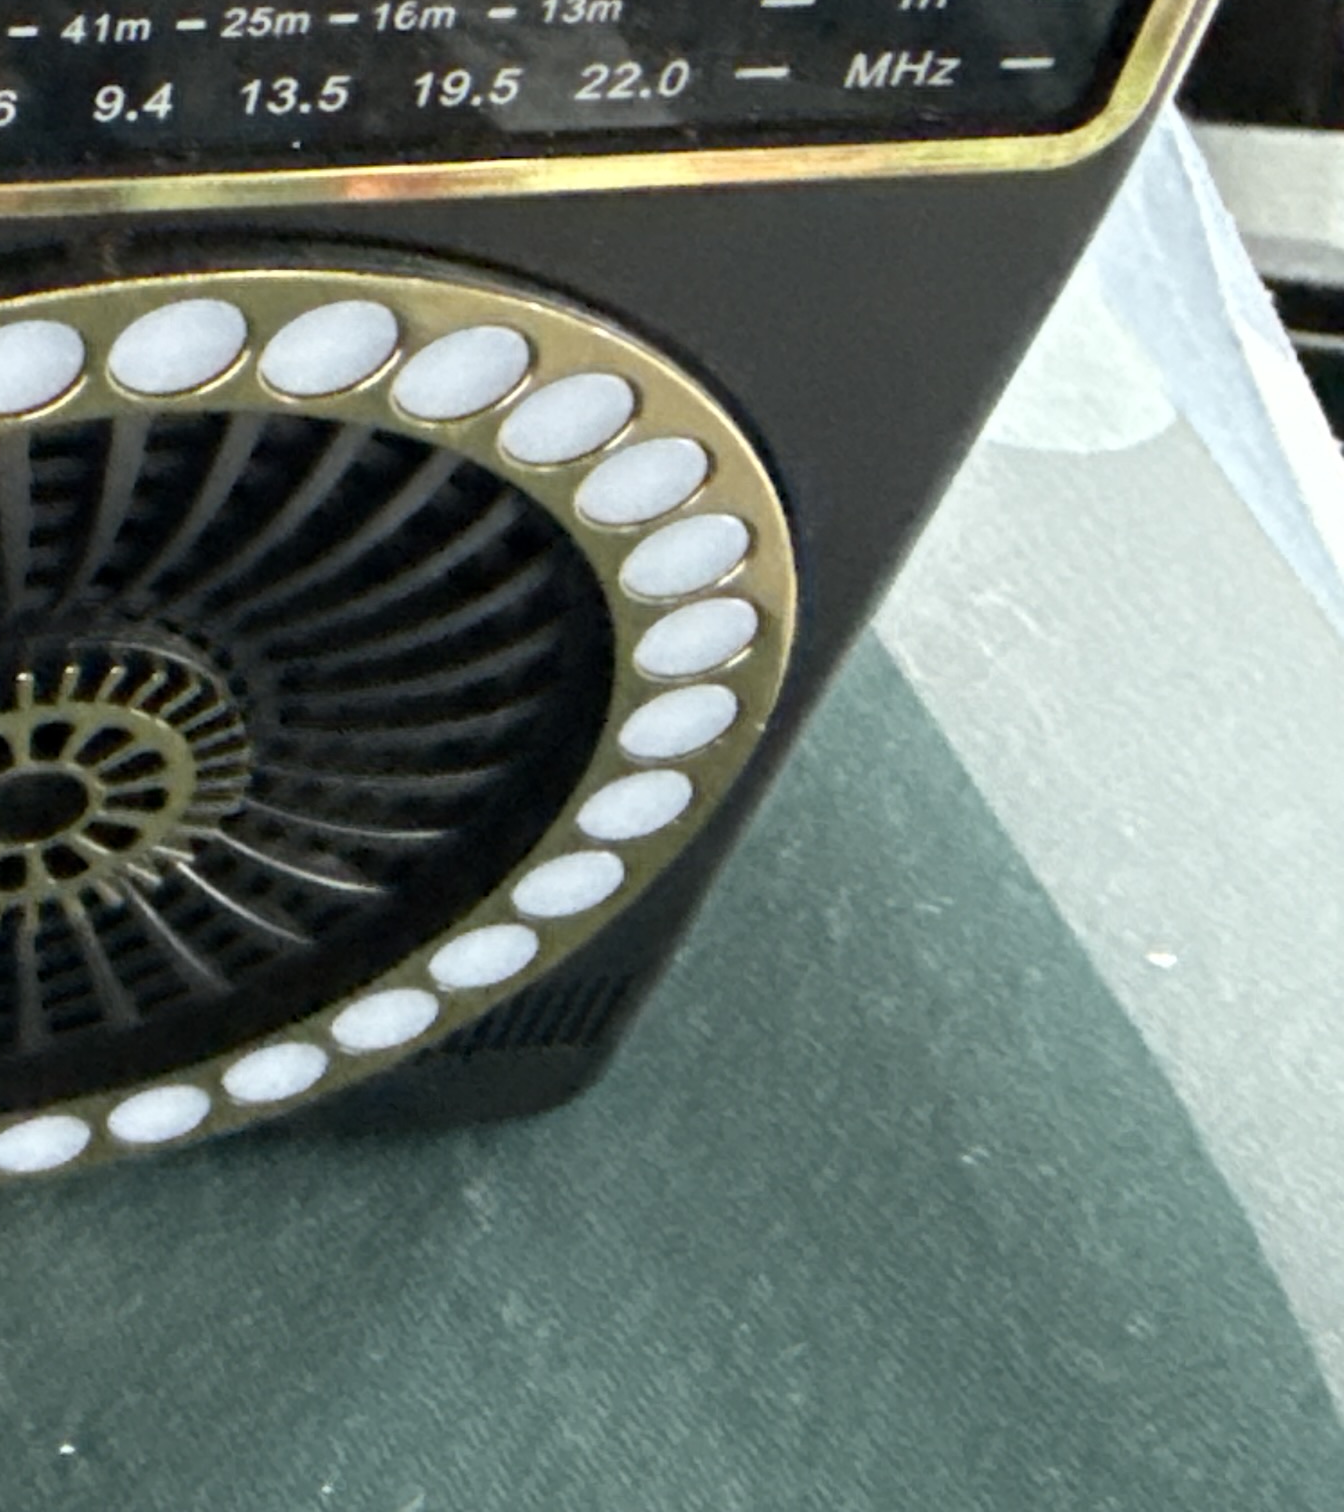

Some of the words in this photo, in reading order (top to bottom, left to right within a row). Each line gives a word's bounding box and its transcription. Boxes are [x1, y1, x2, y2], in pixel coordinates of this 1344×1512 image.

[61, 13, 151, 44] 41m
[220, 6, 311, 38] 25m
[375, 0, 457, 30] 16m
[93, 82, 173, 123] 9.4
[242, 75, 351, 115] 13.5
[415, 66, 524, 107] 19.5
[573, 59, 690, 101] 22.0
[844, 51, 960, 88] MHz
